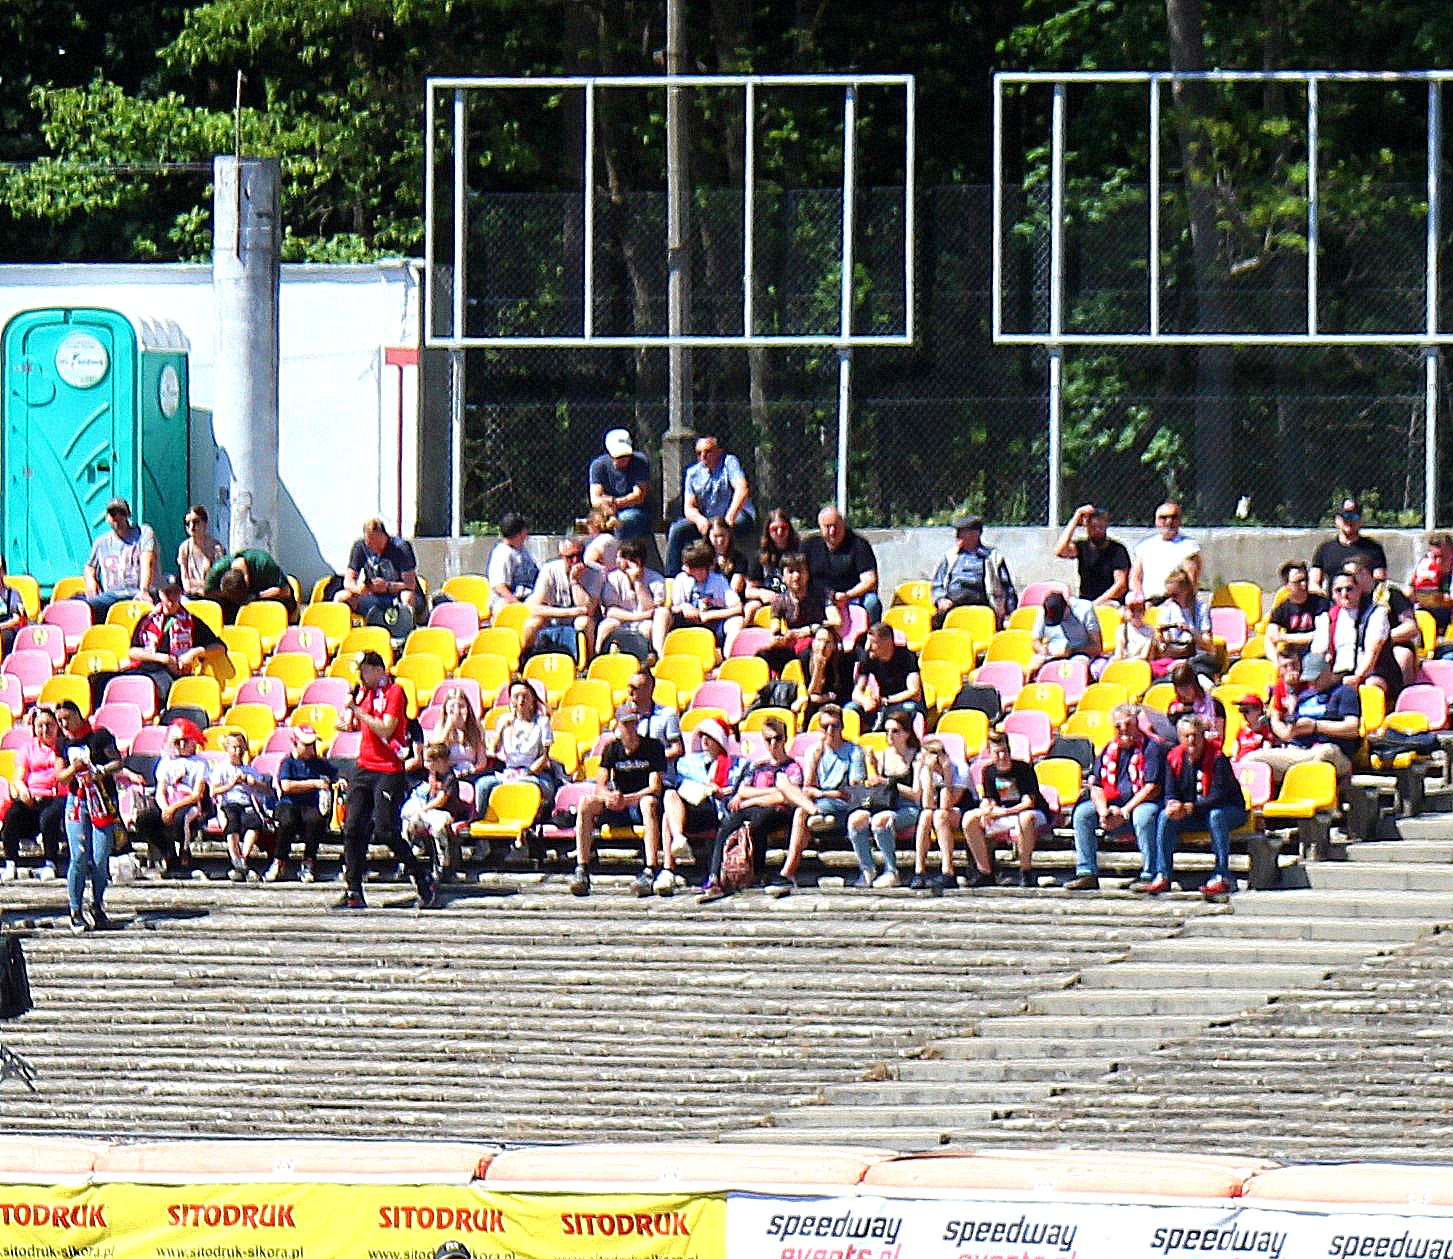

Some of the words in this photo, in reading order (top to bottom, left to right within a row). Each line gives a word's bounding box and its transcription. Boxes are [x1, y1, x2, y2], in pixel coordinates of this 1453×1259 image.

[0, 1203, 108, 1230] TODRUK
[168, 1203, 297, 1230] SITODRUK
[379, 1206, 506, 1233] SITODRUK
[561, 1212, 690, 1238] SITODRUK
[767, 1210, 903, 1245] speedway
[943, 1215, 1077, 1252] speedway
[1151, 1222, 1287, 1259] speedway
